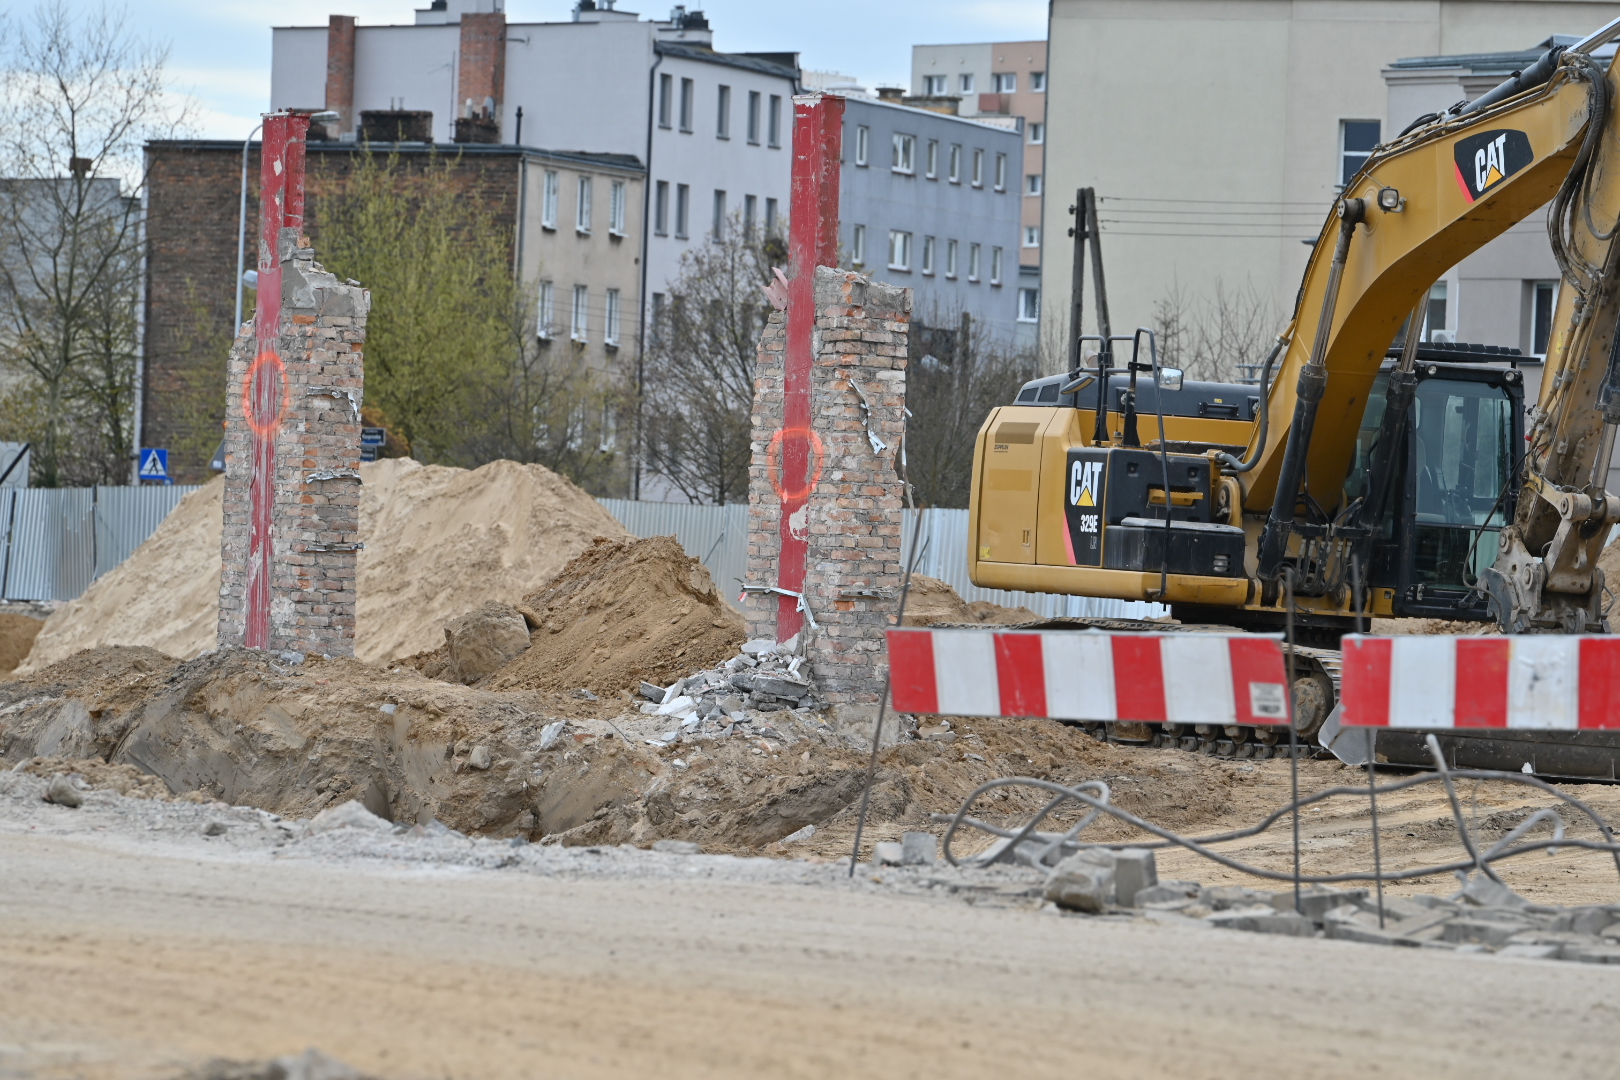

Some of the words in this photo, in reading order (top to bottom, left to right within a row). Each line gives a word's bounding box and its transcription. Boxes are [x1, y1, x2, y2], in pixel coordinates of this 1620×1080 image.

[1475, 133, 1507, 192] CAT
[1070, 460, 1104, 506] CAT
[1080, 514, 1099, 533] 329E
